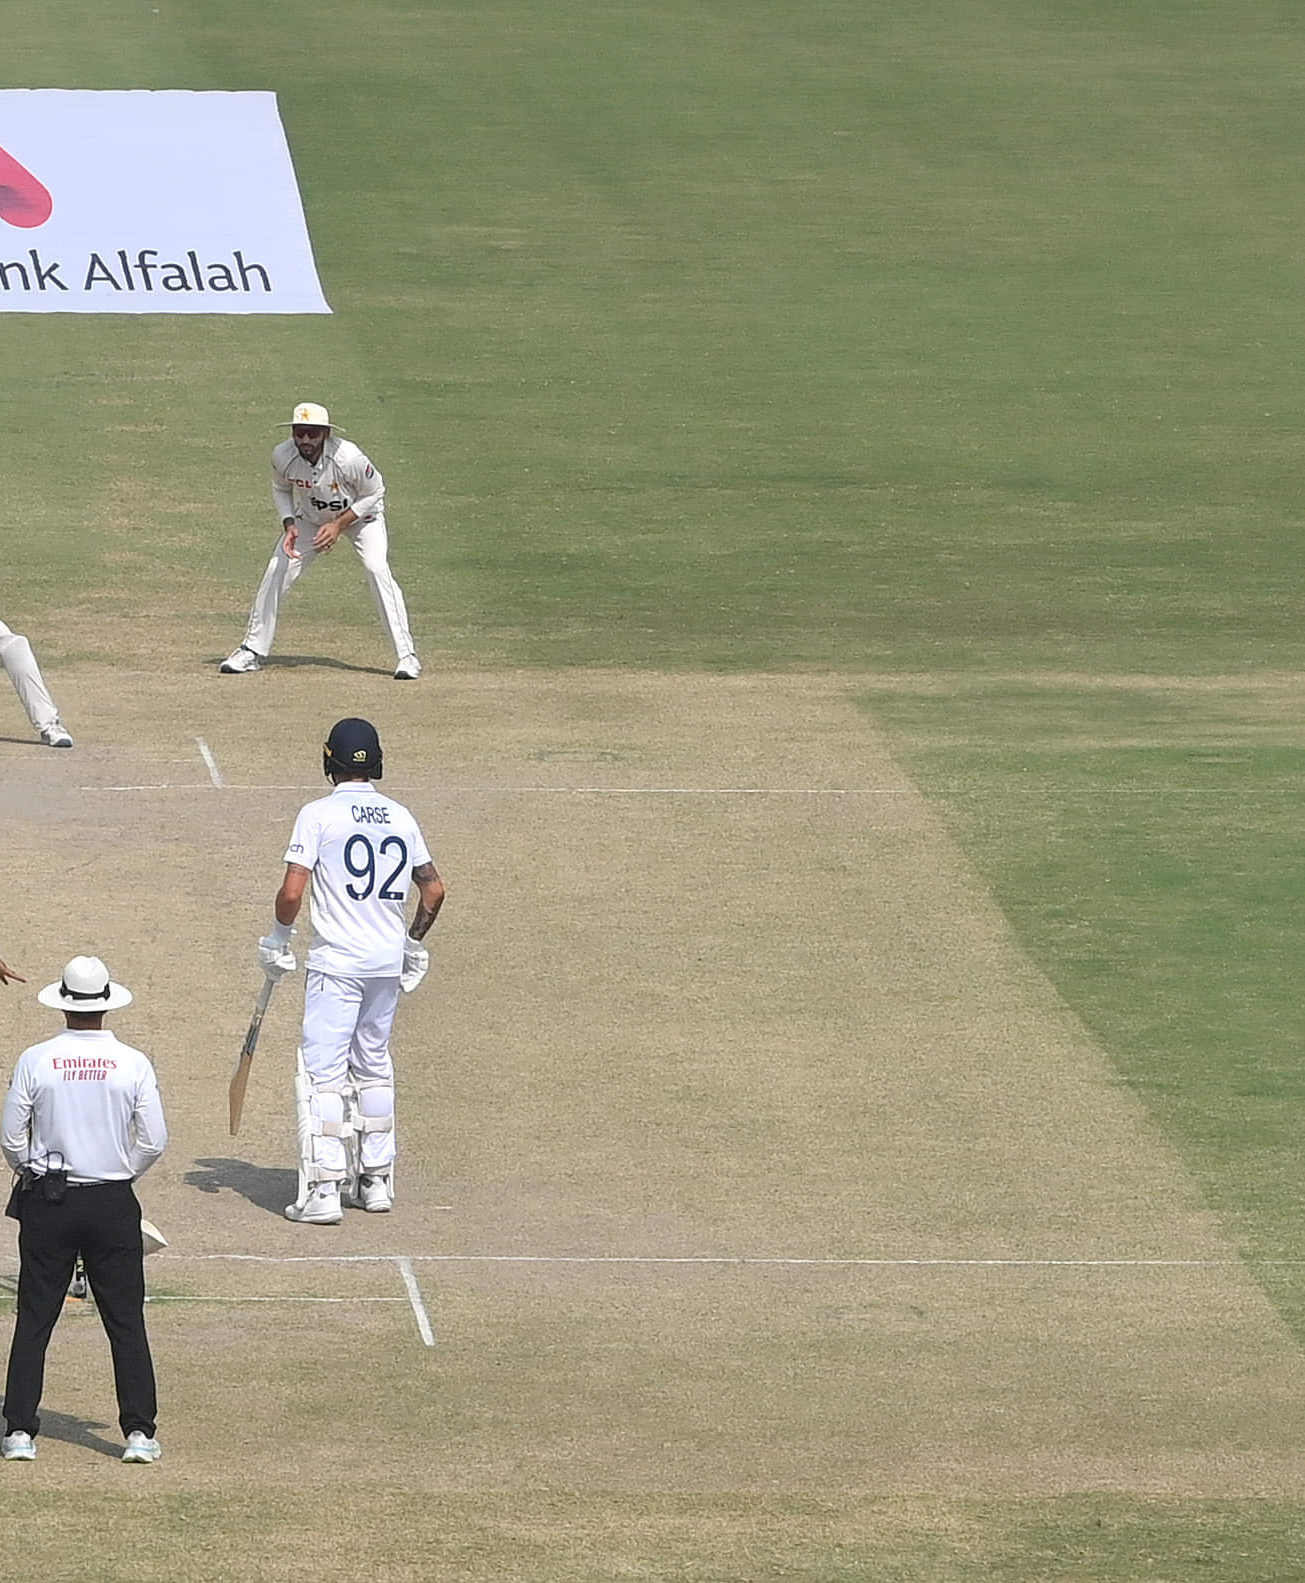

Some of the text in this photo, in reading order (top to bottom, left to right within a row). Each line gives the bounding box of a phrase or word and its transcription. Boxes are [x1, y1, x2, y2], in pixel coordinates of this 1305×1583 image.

[83, 249, 273, 293] Alfalah
[351, 805, 391, 824] CARSE
[343, 833, 408, 902] 92
[52, 1056, 117, 1070] Emirates
[63, 1070, 108, 1081] FLY BETTER
